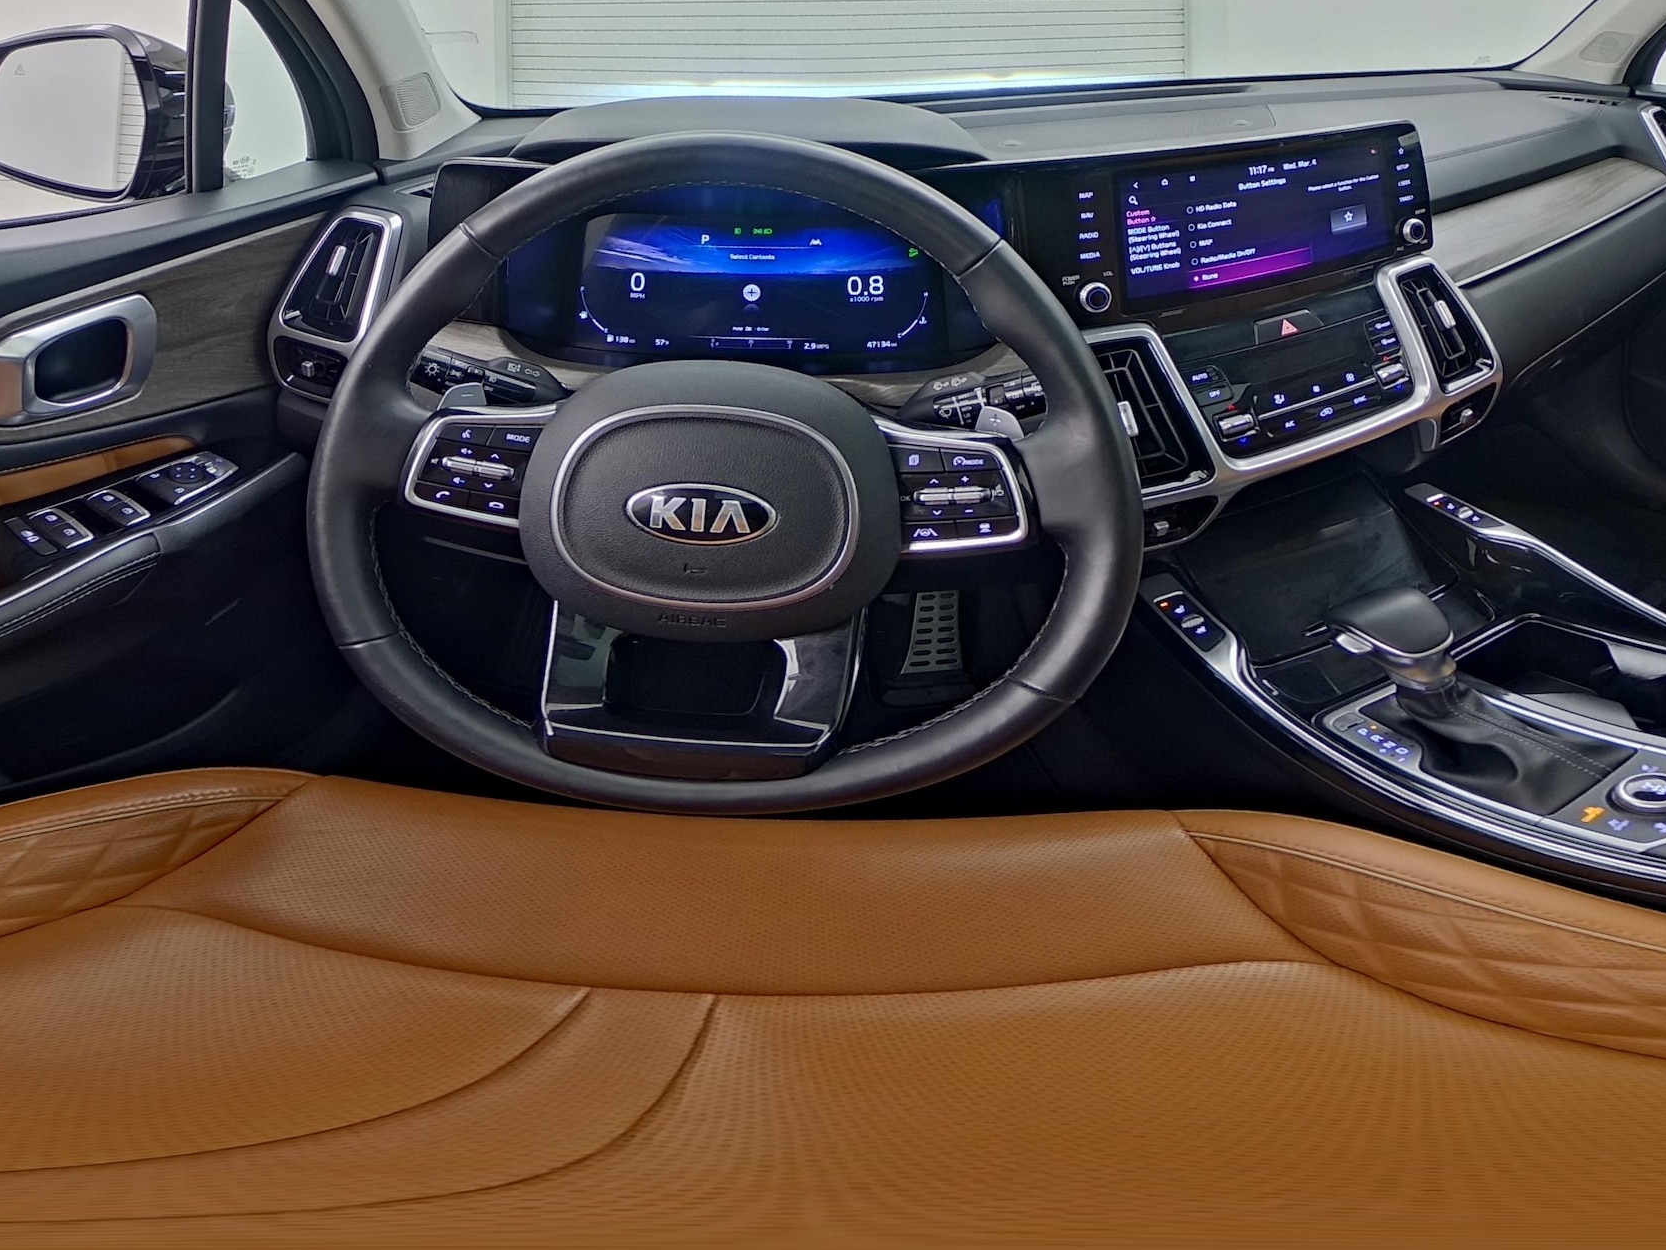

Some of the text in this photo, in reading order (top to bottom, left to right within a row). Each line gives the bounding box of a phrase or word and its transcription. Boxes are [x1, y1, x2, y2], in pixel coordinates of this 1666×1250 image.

[1248, 164, 1268, 176] 11:17
[1238, 177, 1287, 191] Button Settings
[1078, 191, 1094, 200] MAP
[1205, 203, 1222, 212] Radio
[1080, 211, 1094, 220] NAV
[1126, 210, 1150, 218] Custom
[1126, 217, 1150, 226] Button
[1197, 218, 1232, 230] Kia Connect
[1127, 224, 1170, 236] MODE Button
[701, 234, 710, 245] P
[1198, 238, 1213, 247] MAP
[1151, 241, 1177, 251] Buttons
[1079, 251, 1100, 260] MEDIA
[1163, 261, 1181, 271] Knob
[1201, 272, 1218, 281] None
[630, 272, 646, 292] 0
[846, 275, 884, 296] 0.8
[1191, 372, 1209, 382] AUTO
[1208, 389, 1221, 399] OFF
[505, 433, 531, 444] MODE
[649, 494, 751, 534] KIA
[1356, 727, 1369, 736] P
[1394, 747, 1409, 755] D
